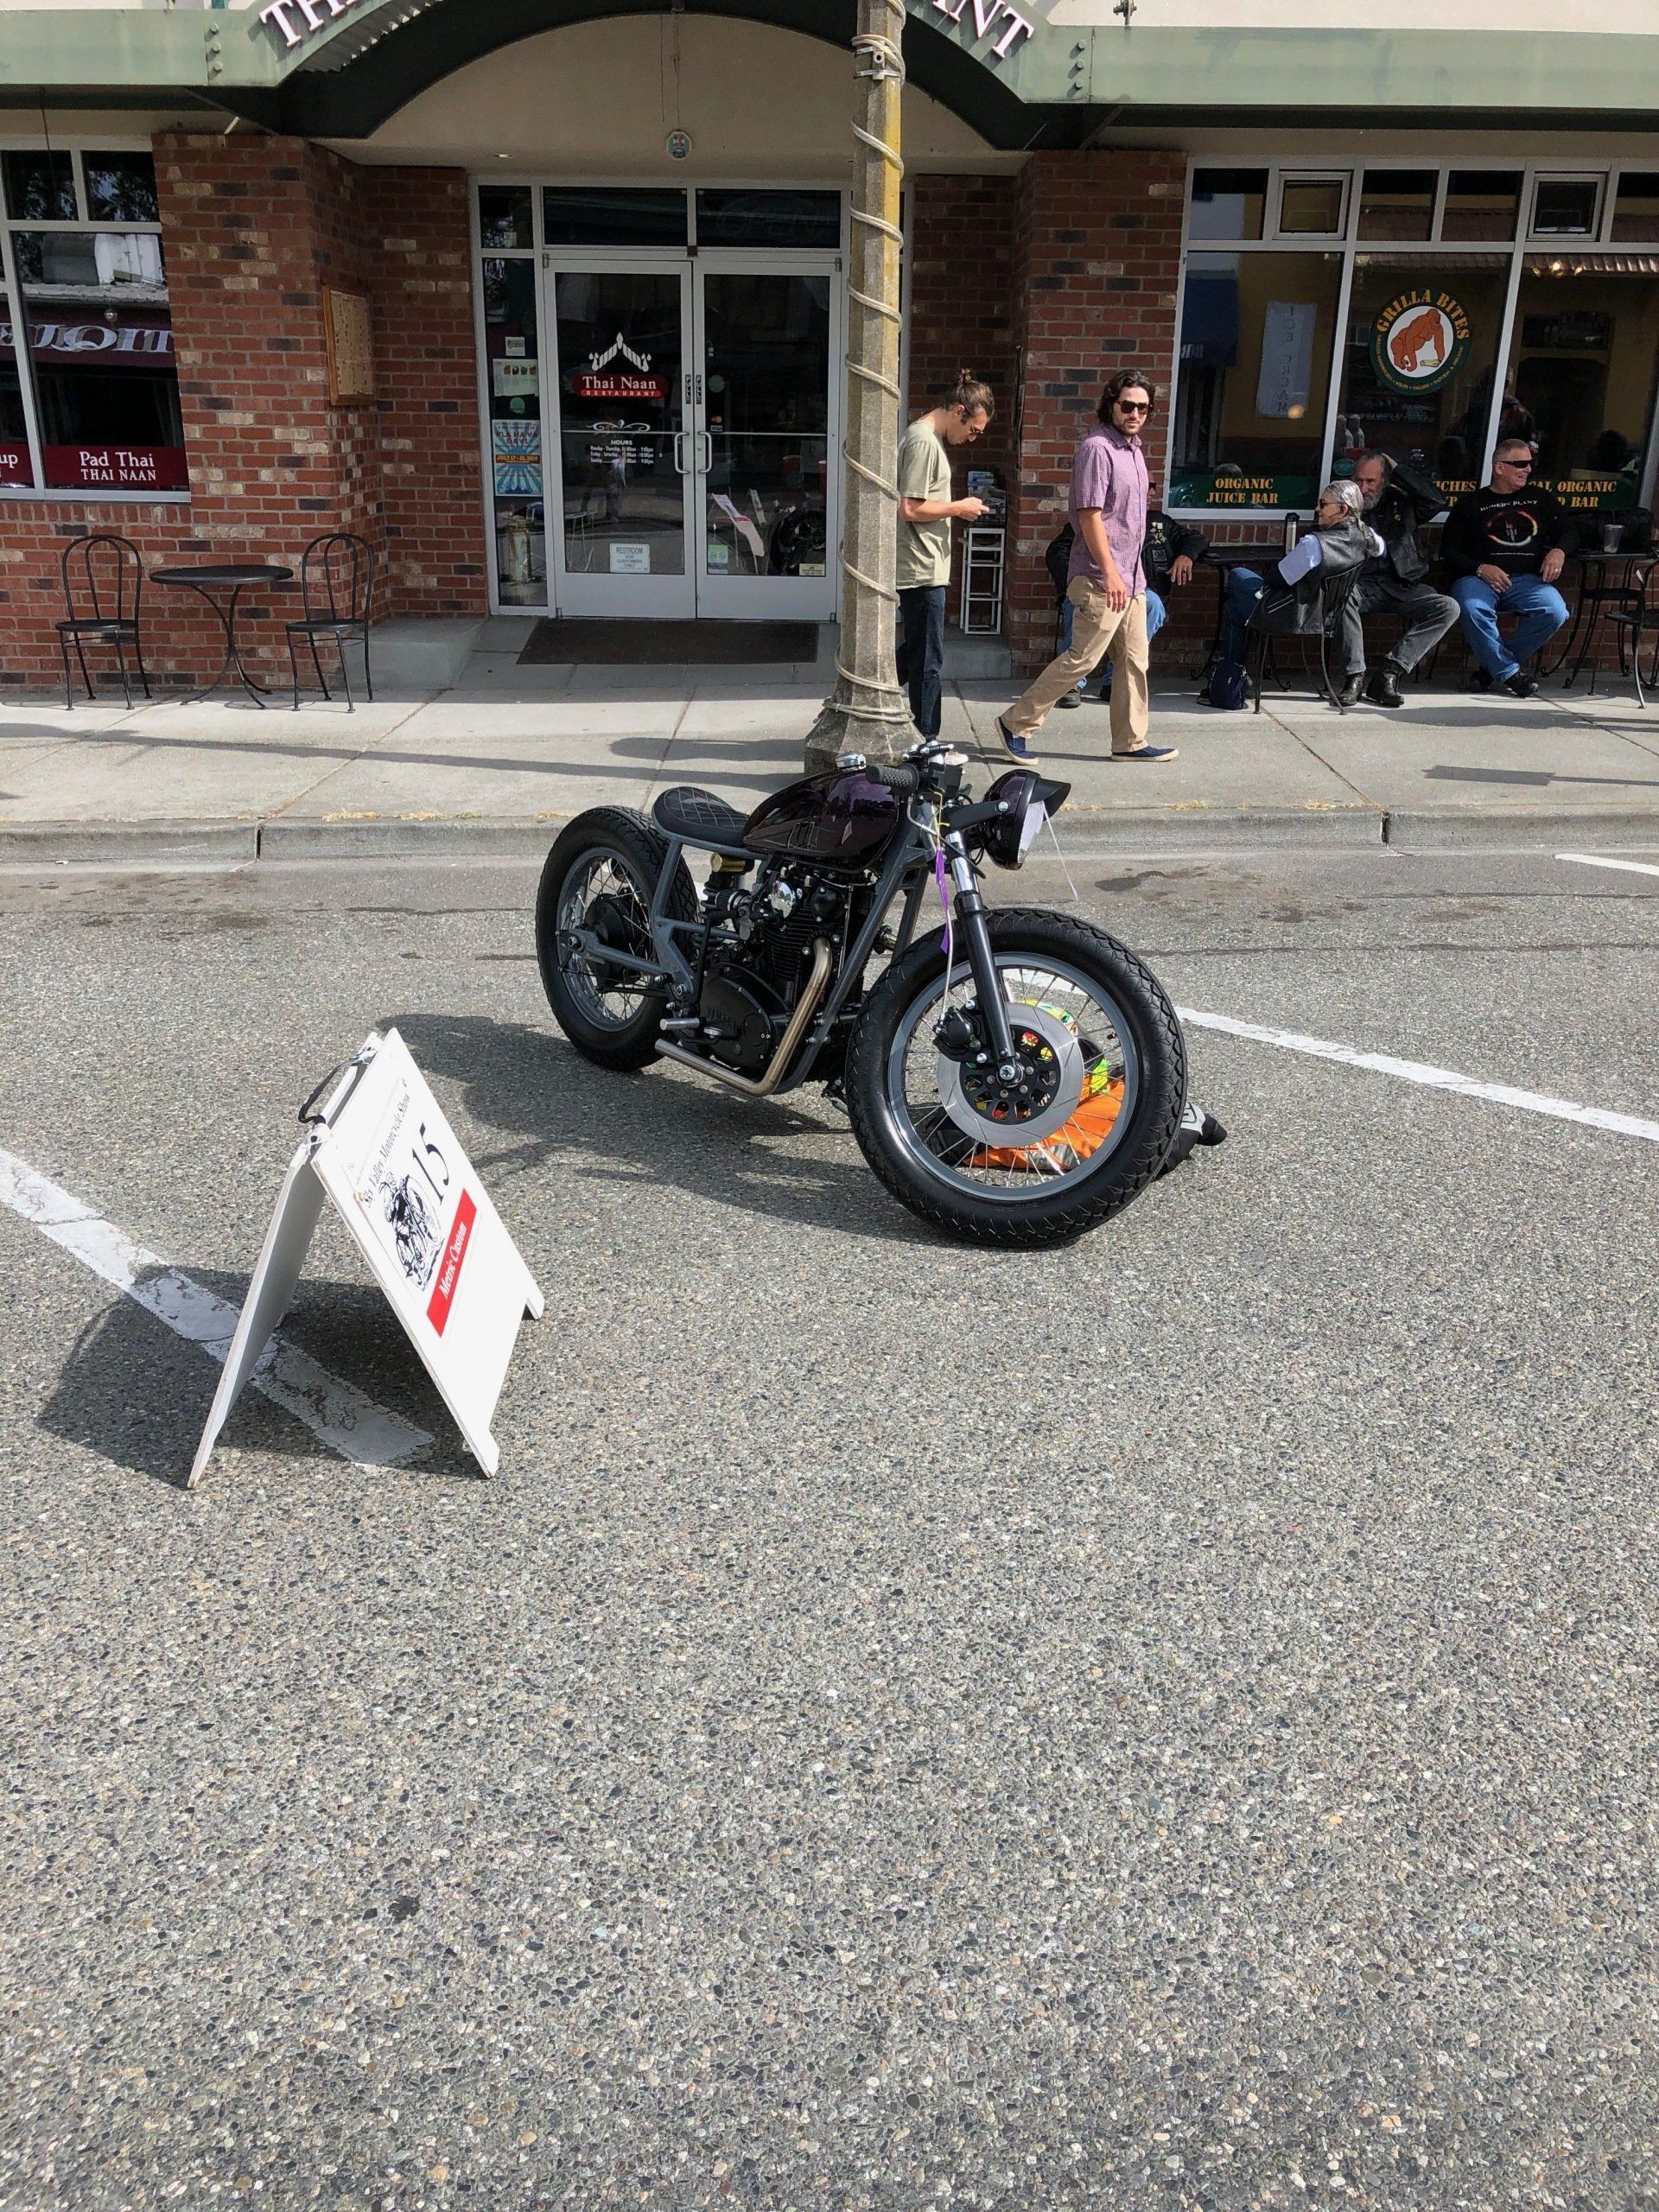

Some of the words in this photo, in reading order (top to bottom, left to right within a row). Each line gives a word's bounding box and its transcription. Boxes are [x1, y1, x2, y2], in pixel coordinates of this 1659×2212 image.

[1376, 289, 1432, 333] GRILLA
[1436, 292, 1471, 340] BITES
[582, 376, 614, 390] Thai
[620, 377, 658, 390] Naan
[79, 451, 109, 467] Pad
[115, 451, 155, 467] Thai
[81, 469, 114, 480] THAI
[119, 469, 156, 481] NAAN
[1215, 478, 1274, 489] ORGANIC
[1557, 480, 1618, 493] ORGANIC
[1206, 492, 1246, 504] JUICE
[1251, 493, 1279, 504] BAR
[1570, 496, 1599, 508] BAR
[397, 1093, 410, 1116] Show
[378, 1118, 404, 1163] Motorcycle
[411, 1122, 449, 1206] 15
[369, 1160, 387, 1188] Valley
[363, 1189, 376, 1209] Sky
[438, 1257, 456, 1300] Metric
[449, 1220, 467, 1261] Custom
